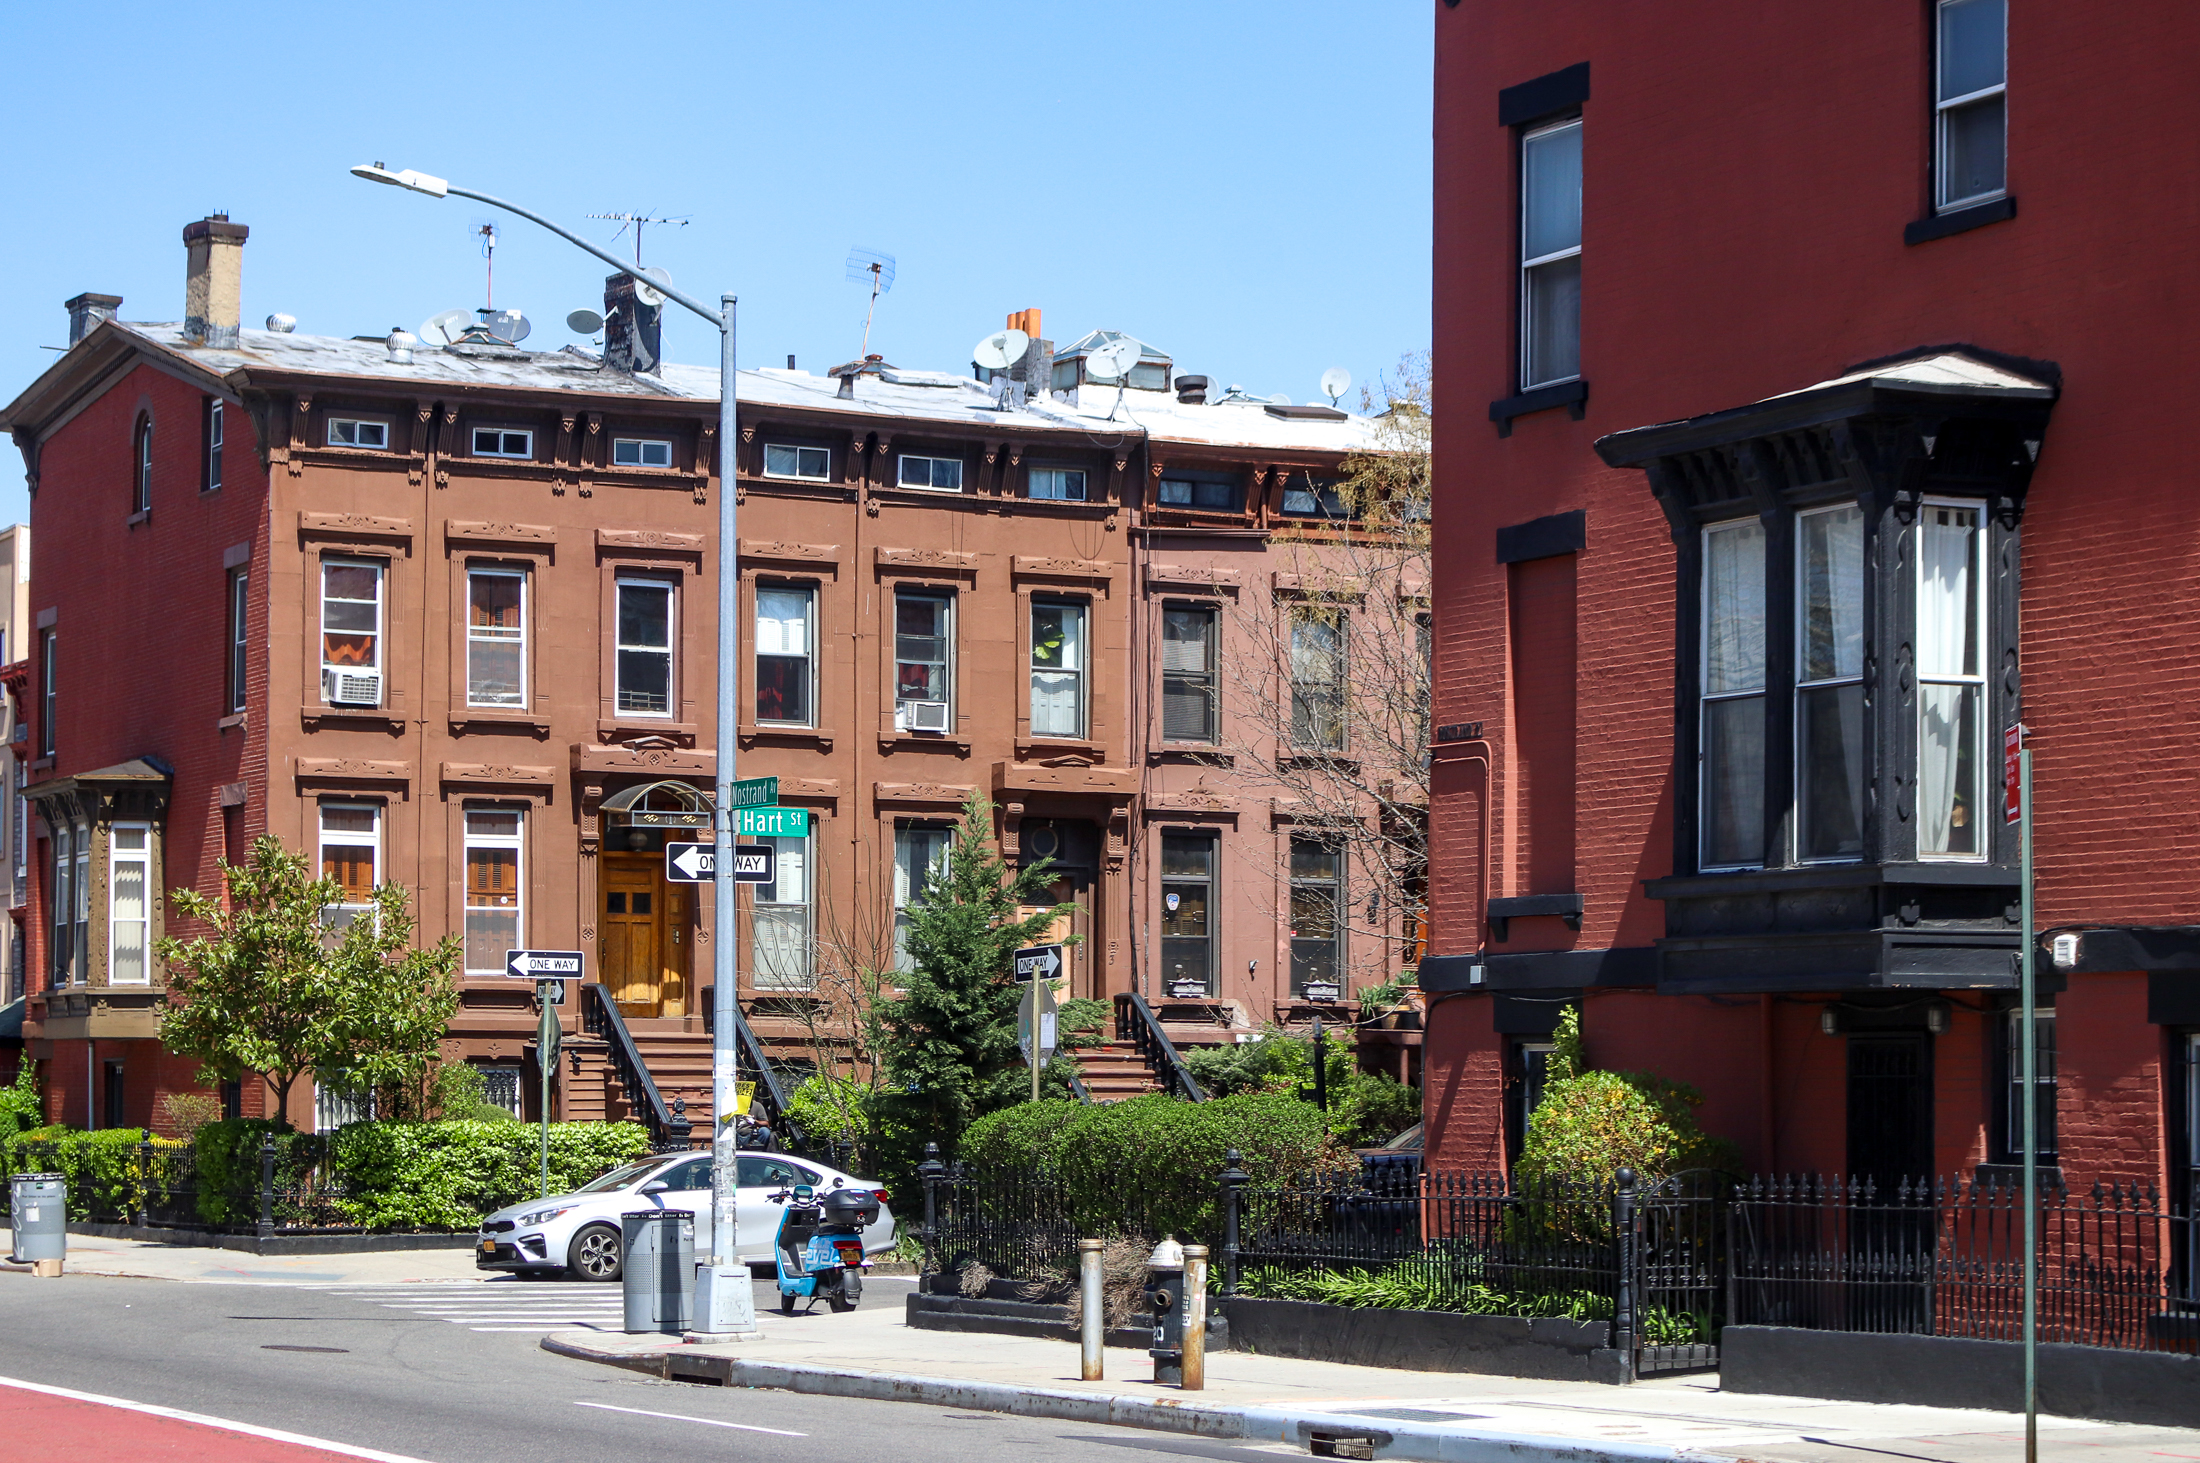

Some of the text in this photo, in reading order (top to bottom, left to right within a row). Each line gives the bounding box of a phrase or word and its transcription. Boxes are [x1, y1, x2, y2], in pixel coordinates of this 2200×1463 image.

[733, 780, 776, 805] Nostrand Av
[744, 811, 801, 832] Hart St
[700, 855, 716, 869] ON
[530, 959, 575, 970] ONE WAY
[1020, 959, 1032, 972] ONE
